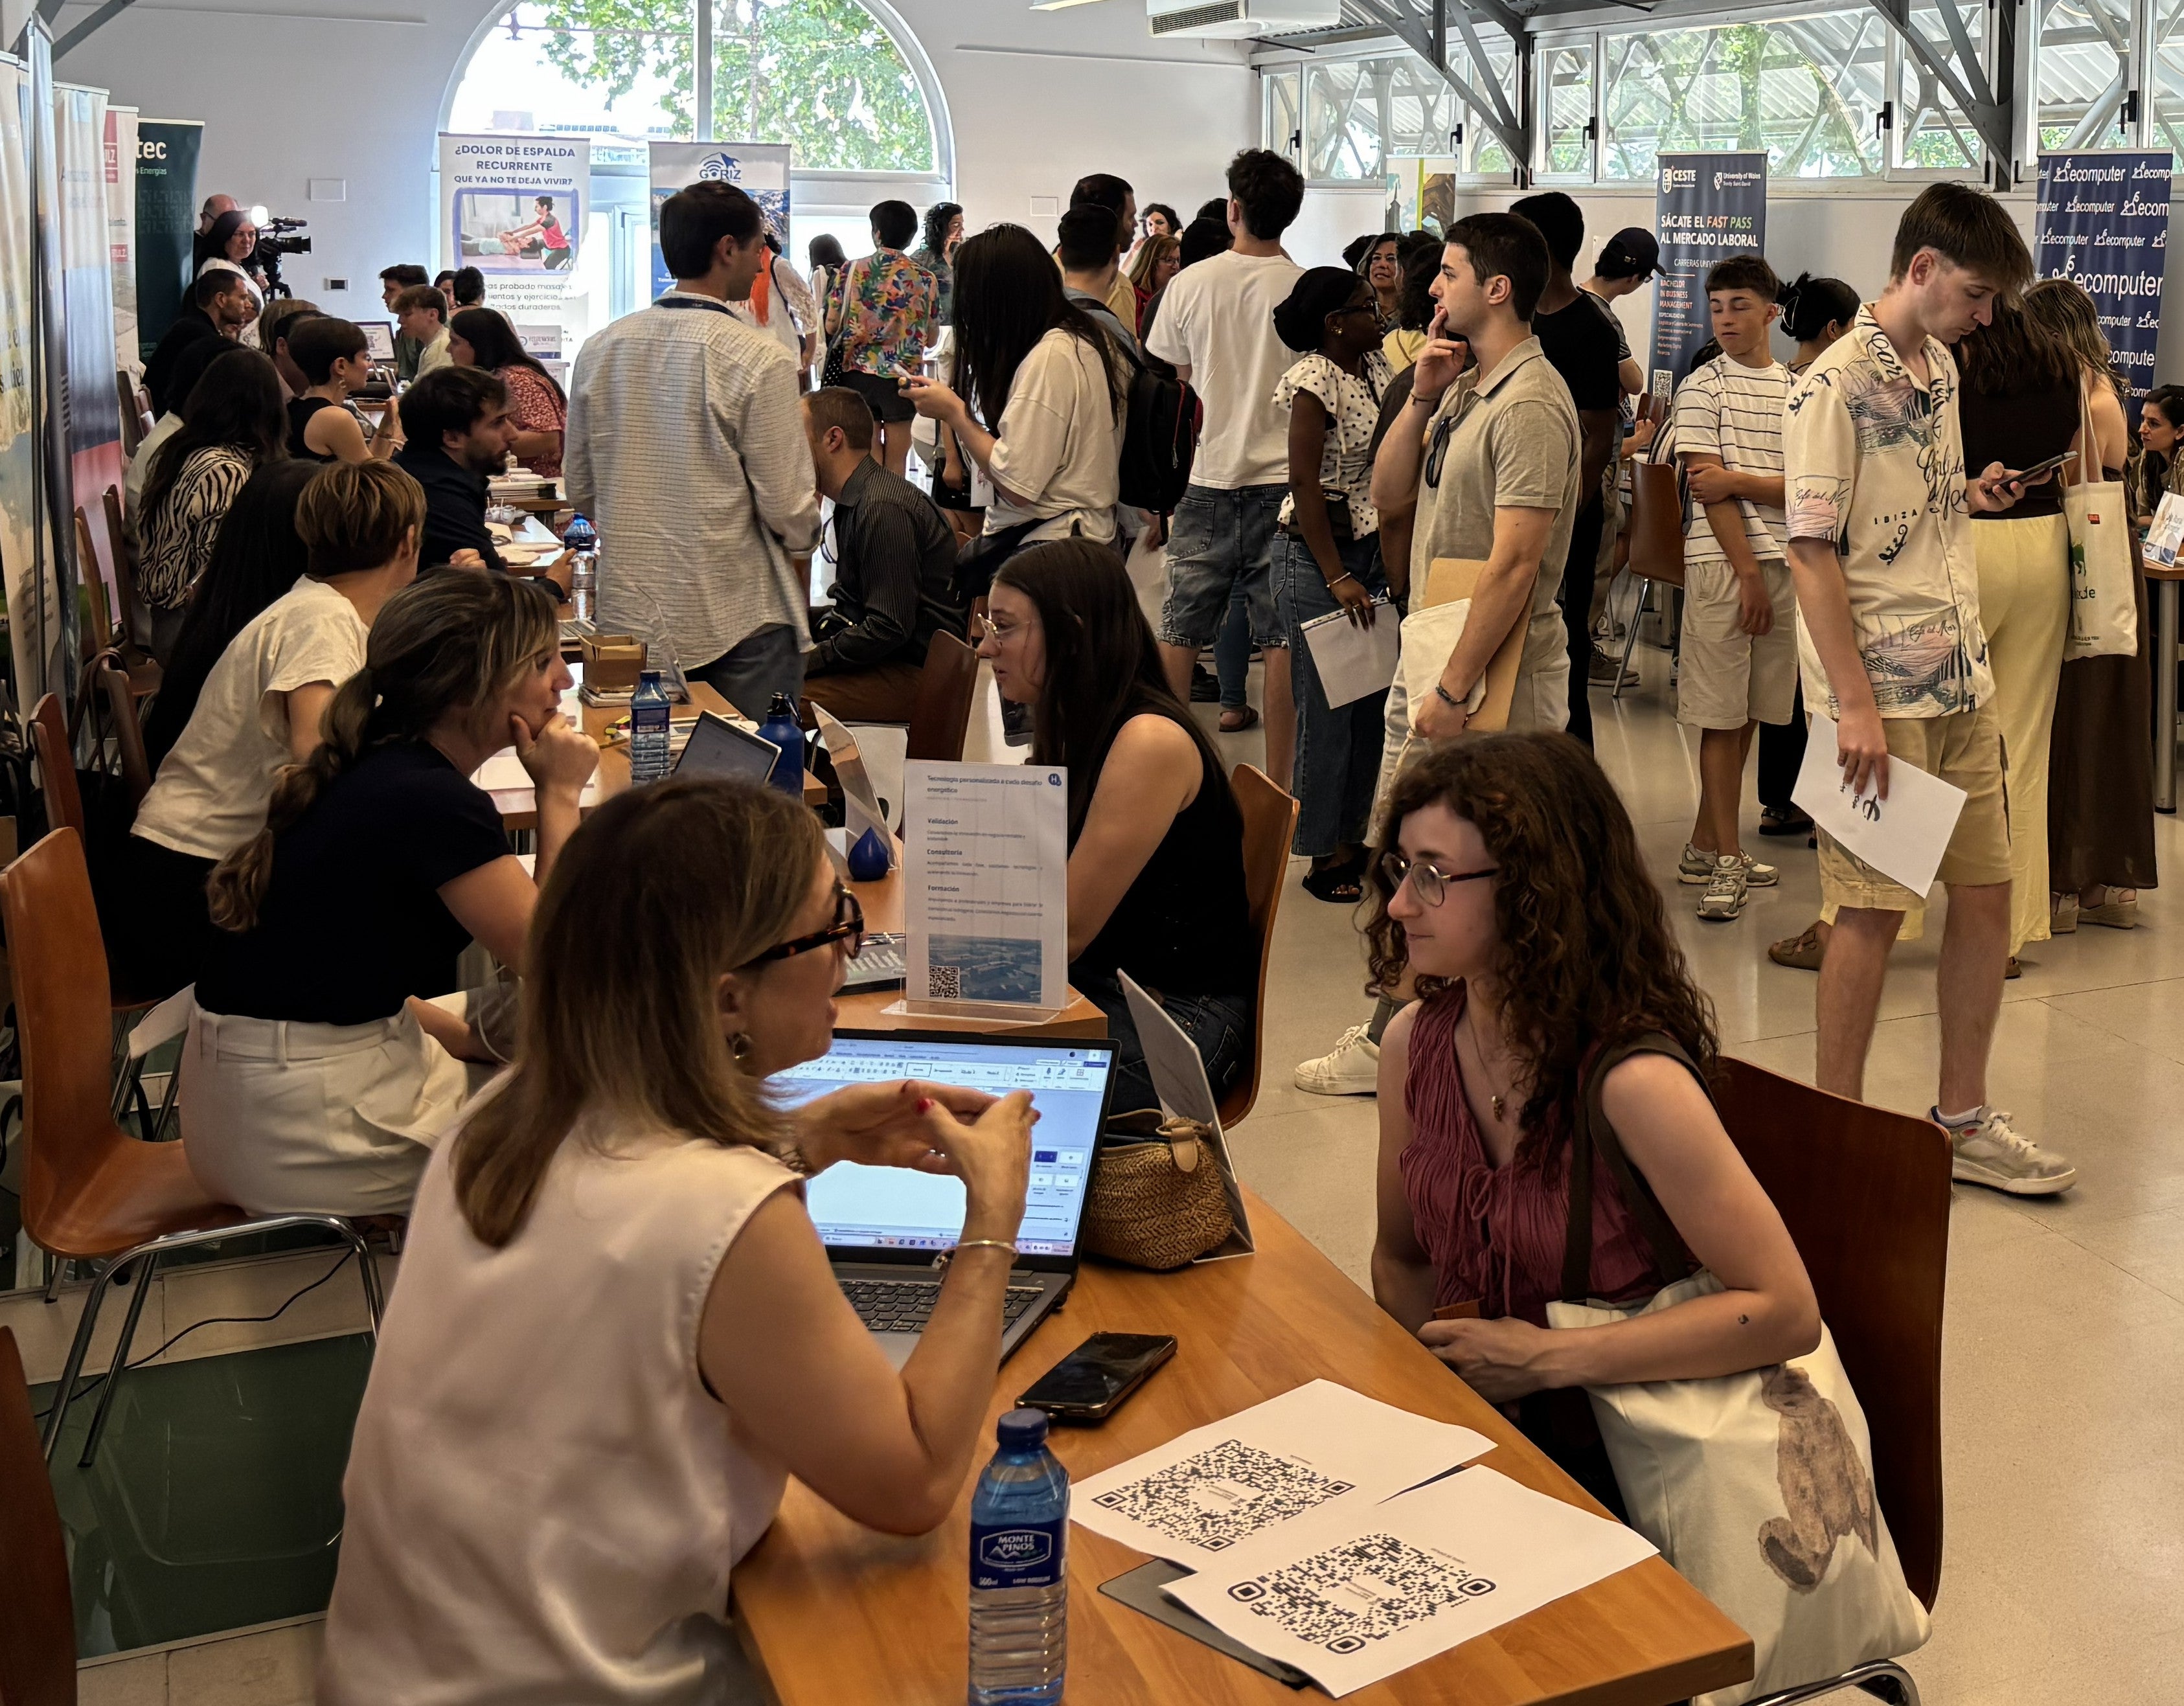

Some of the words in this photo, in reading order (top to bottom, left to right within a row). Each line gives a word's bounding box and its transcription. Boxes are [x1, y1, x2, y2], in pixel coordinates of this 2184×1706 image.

[455, 145, 503, 155] ¿DOLOR
[506, 146, 520, 155] DE
[523, 147, 575, 157] ESPALDA
[477, 161, 552, 171] RECURRENTE
[1673, 170, 1696, 181] CESTE
[2069, 166, 2126, 185] ecomputer
[2076, 201, 2115, 215] ecomputer
[1661, 212, 1692, 228] SÁCATE
[1694, 216, 1704, 228] EL
[1707, 216, 1728, 229] FAST
[1730, 217, 1752, 229] PASS
[1660, 233, 1670, 244] AL
[1673, 233, 1716, 245] MERCADO
[1718, 234, 1758, 247] LABORAL
[2051, 234, 2089, 247] ecomputer
[2106, 235, 2145, 249] ecomputer
[2073, 271, 2163, 301] ecomputer
[1659, 301, 1692, 309] MANAGEMENT
[2098, 315, 2131, 328] computer
[2108, 350, 2155, 368] compute
[1874, 508, 1917, 525] IBIZA
[998, 1534, 1034, 1544] MONTE
[1003, 1543, 1035, 1551] PINOS
